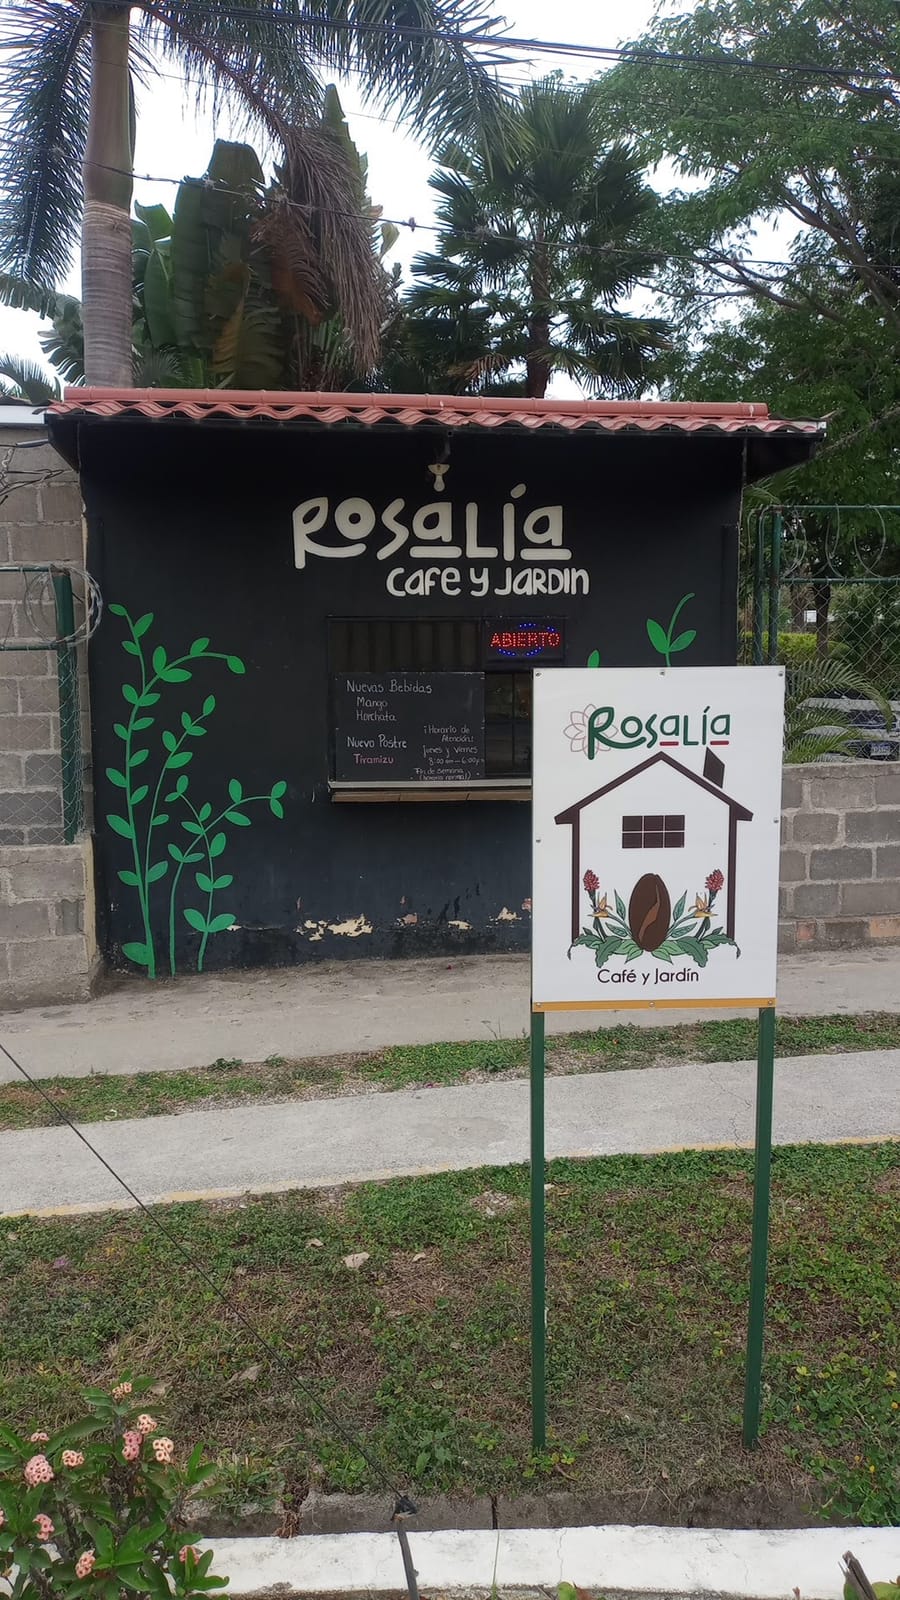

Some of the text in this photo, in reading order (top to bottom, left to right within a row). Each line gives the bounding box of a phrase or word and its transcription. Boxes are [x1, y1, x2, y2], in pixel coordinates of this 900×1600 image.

[469, 567, 489, 596] y
[490, 632, 561, 647] ABIERTO
[346, 679, 433, 694] Nuevas Bebidas
[356, 696, 388, 710] Mango
[356, 710, 397, 722] Horchata
[460, 724, 471, 734] de
[347, 734, 408, 749] Nuevo Postre
[353, 753, 394, 764] Tiramizu
[597, 967, 699, 986] Café y Jardín
